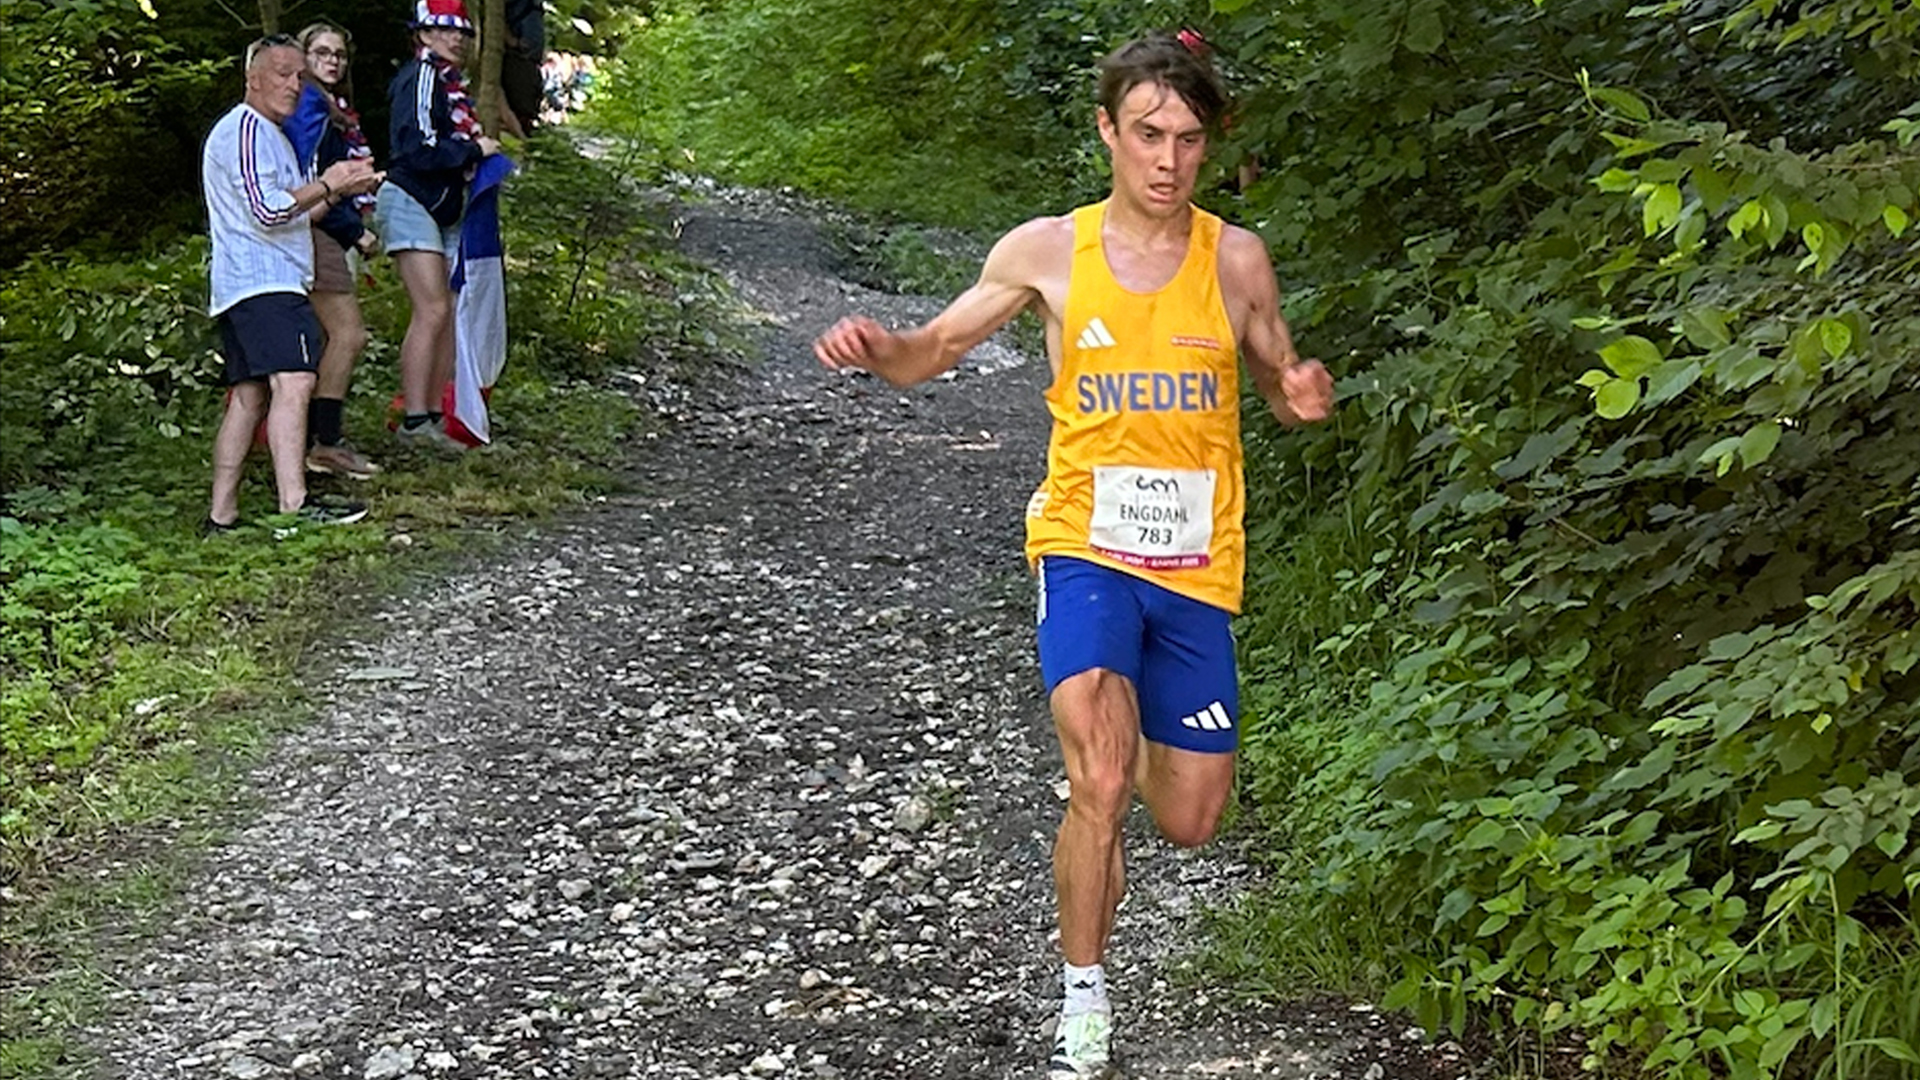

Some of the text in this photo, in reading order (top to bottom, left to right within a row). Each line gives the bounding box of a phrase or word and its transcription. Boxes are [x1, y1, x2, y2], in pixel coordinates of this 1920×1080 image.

[1078, 371, 1218, 413] SWEDEN
[1120, 504, 1189, 523] ENGDAHL
[1137, 526, 1173, 545] 783
